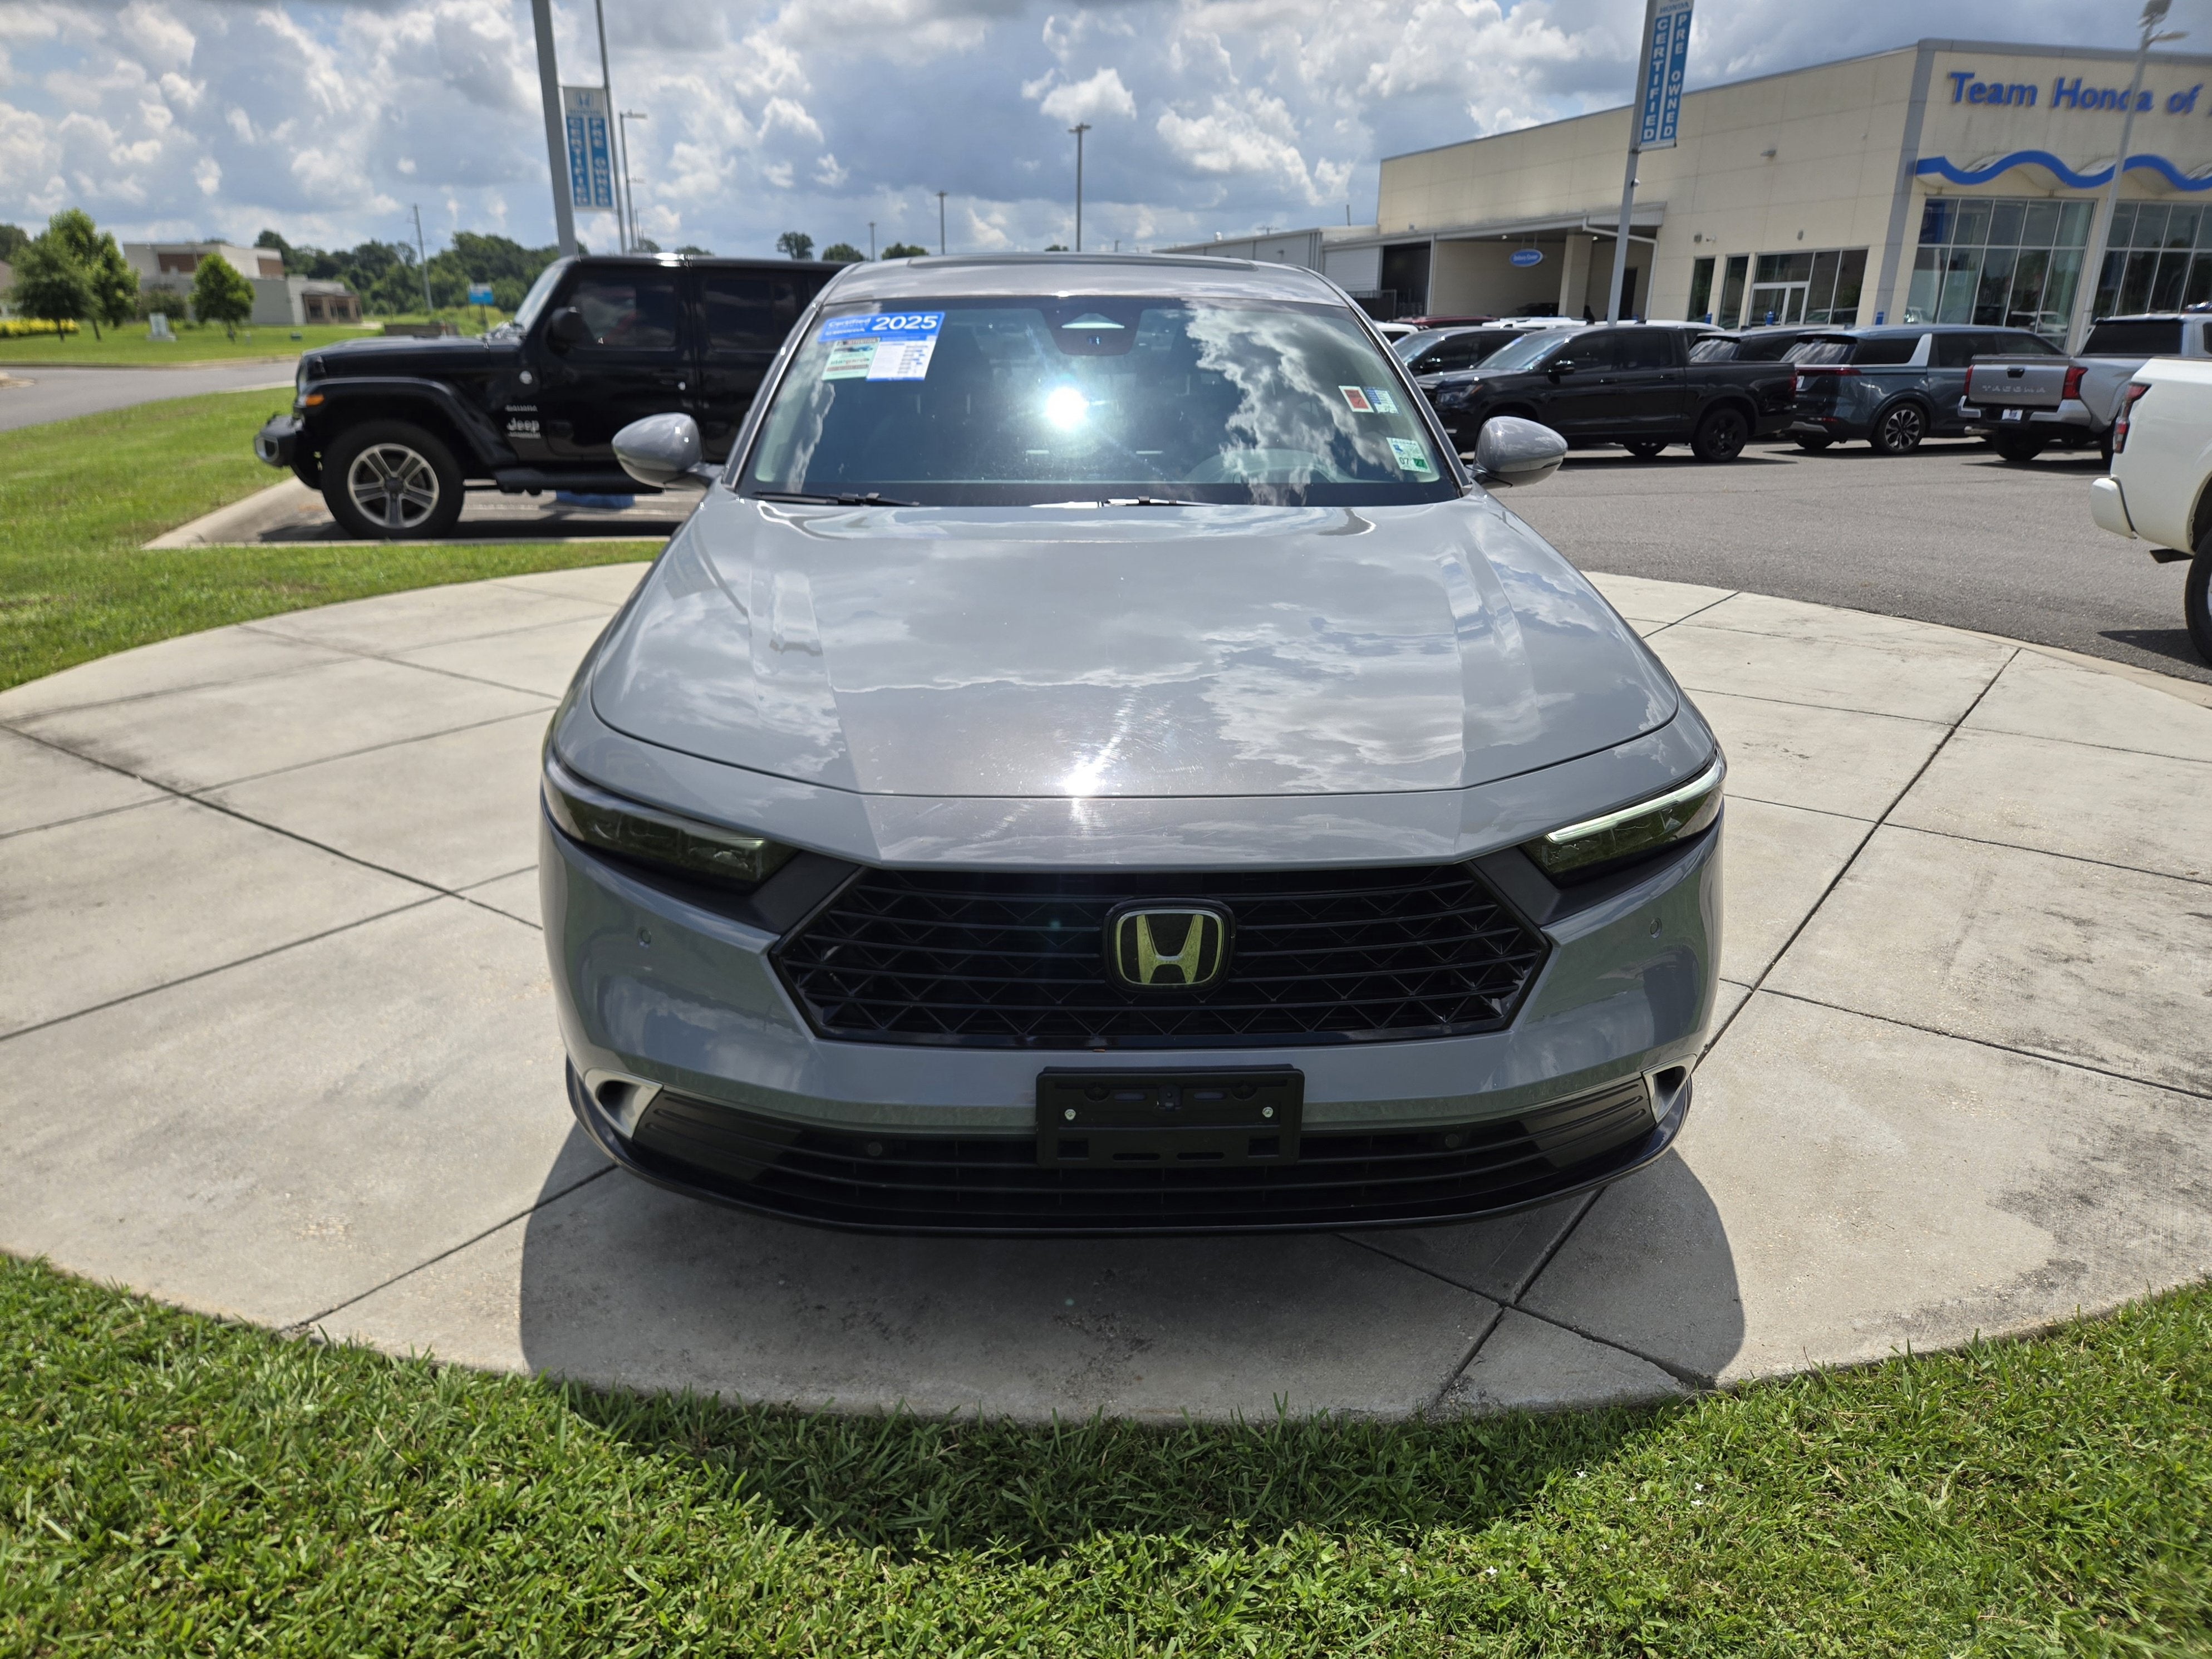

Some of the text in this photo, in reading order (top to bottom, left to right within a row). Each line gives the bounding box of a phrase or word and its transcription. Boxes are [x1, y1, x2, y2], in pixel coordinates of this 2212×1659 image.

[1644, 18, 1668, 140] CERTIFIED
[1663, 13, 1688, 137] PRE OWNED
[1949, 71, 2038, 106] Team
[2167, 83, 2204, 115] of
[872, 316, 938, 331] 2025
[507, 417, 540, 433] Jeep
[1399, 457, 1409, 465] 07
